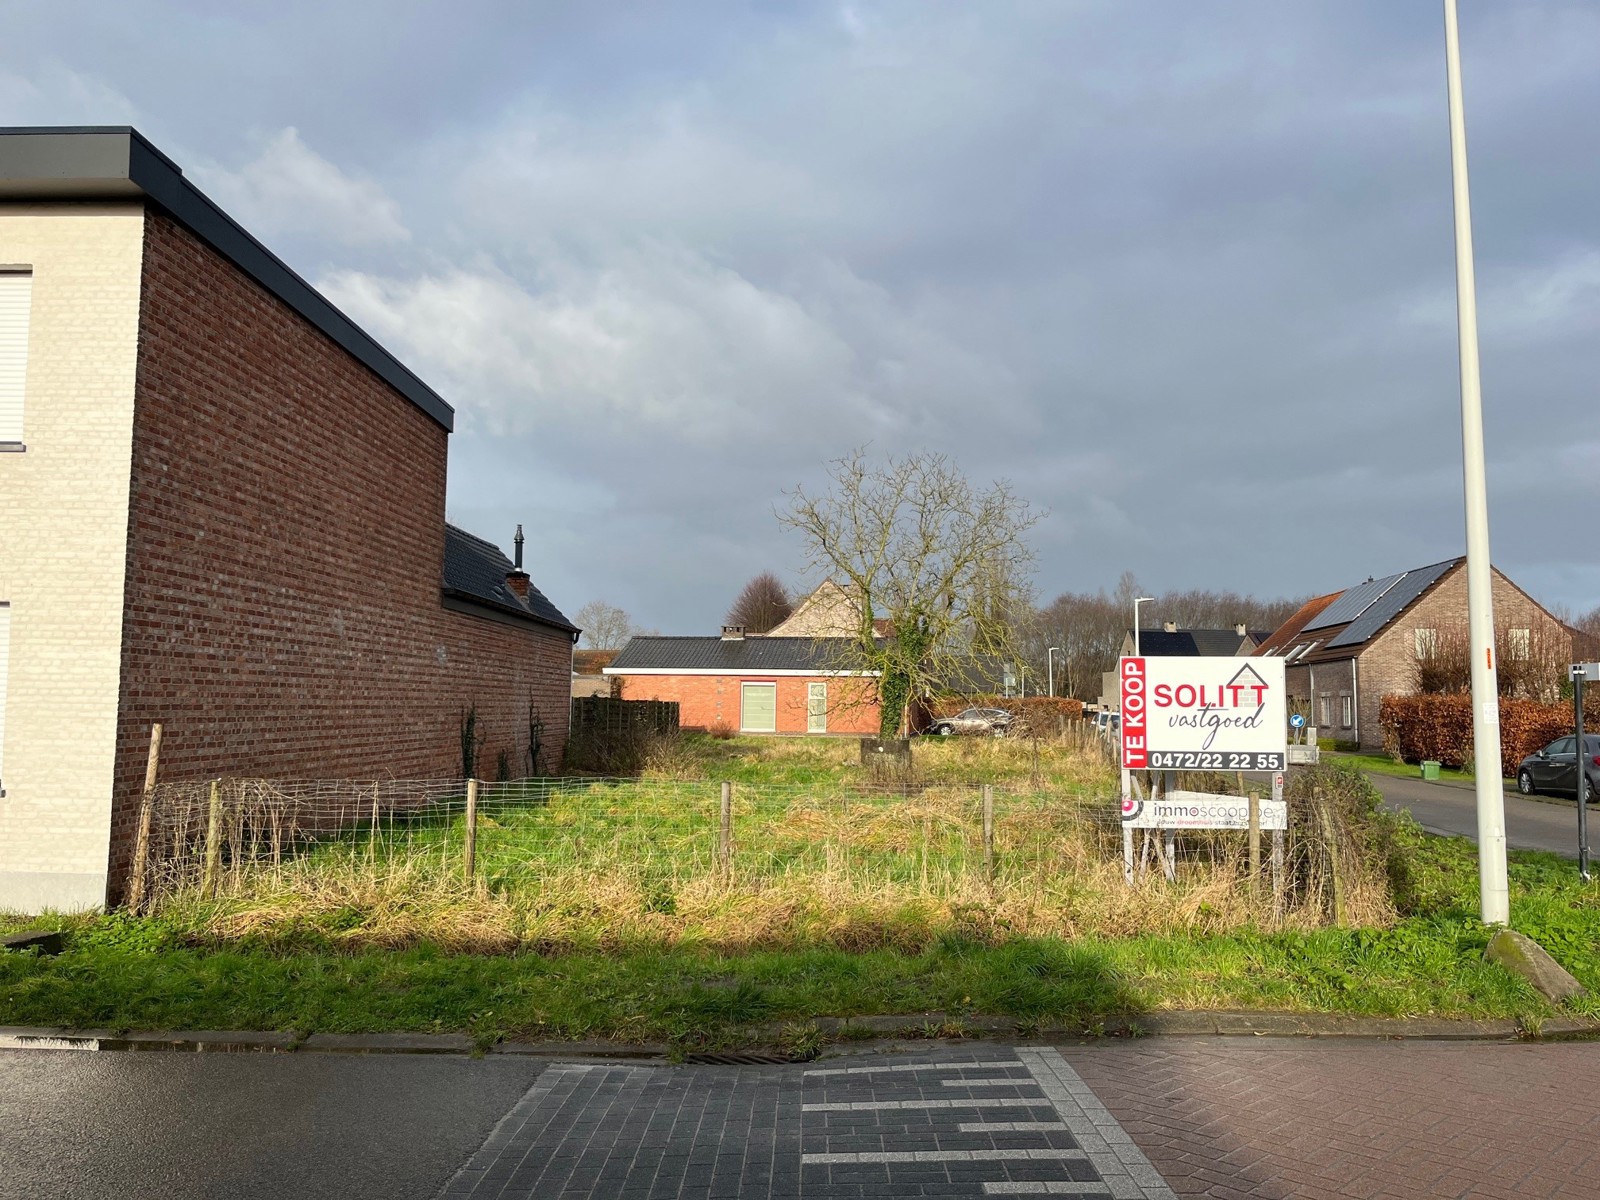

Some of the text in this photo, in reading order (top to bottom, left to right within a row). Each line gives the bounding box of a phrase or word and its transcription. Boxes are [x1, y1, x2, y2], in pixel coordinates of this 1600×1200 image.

[1154, 684, 1270, 708] SOLITT
[1125, 661, 1145, 764] TE KOOP
[1168, 702, 1265, 750] vastgoed
[1152, 753, 1279, 769] 0472/22 22 55
[1154, 802, 1273, 820] immoscoope
